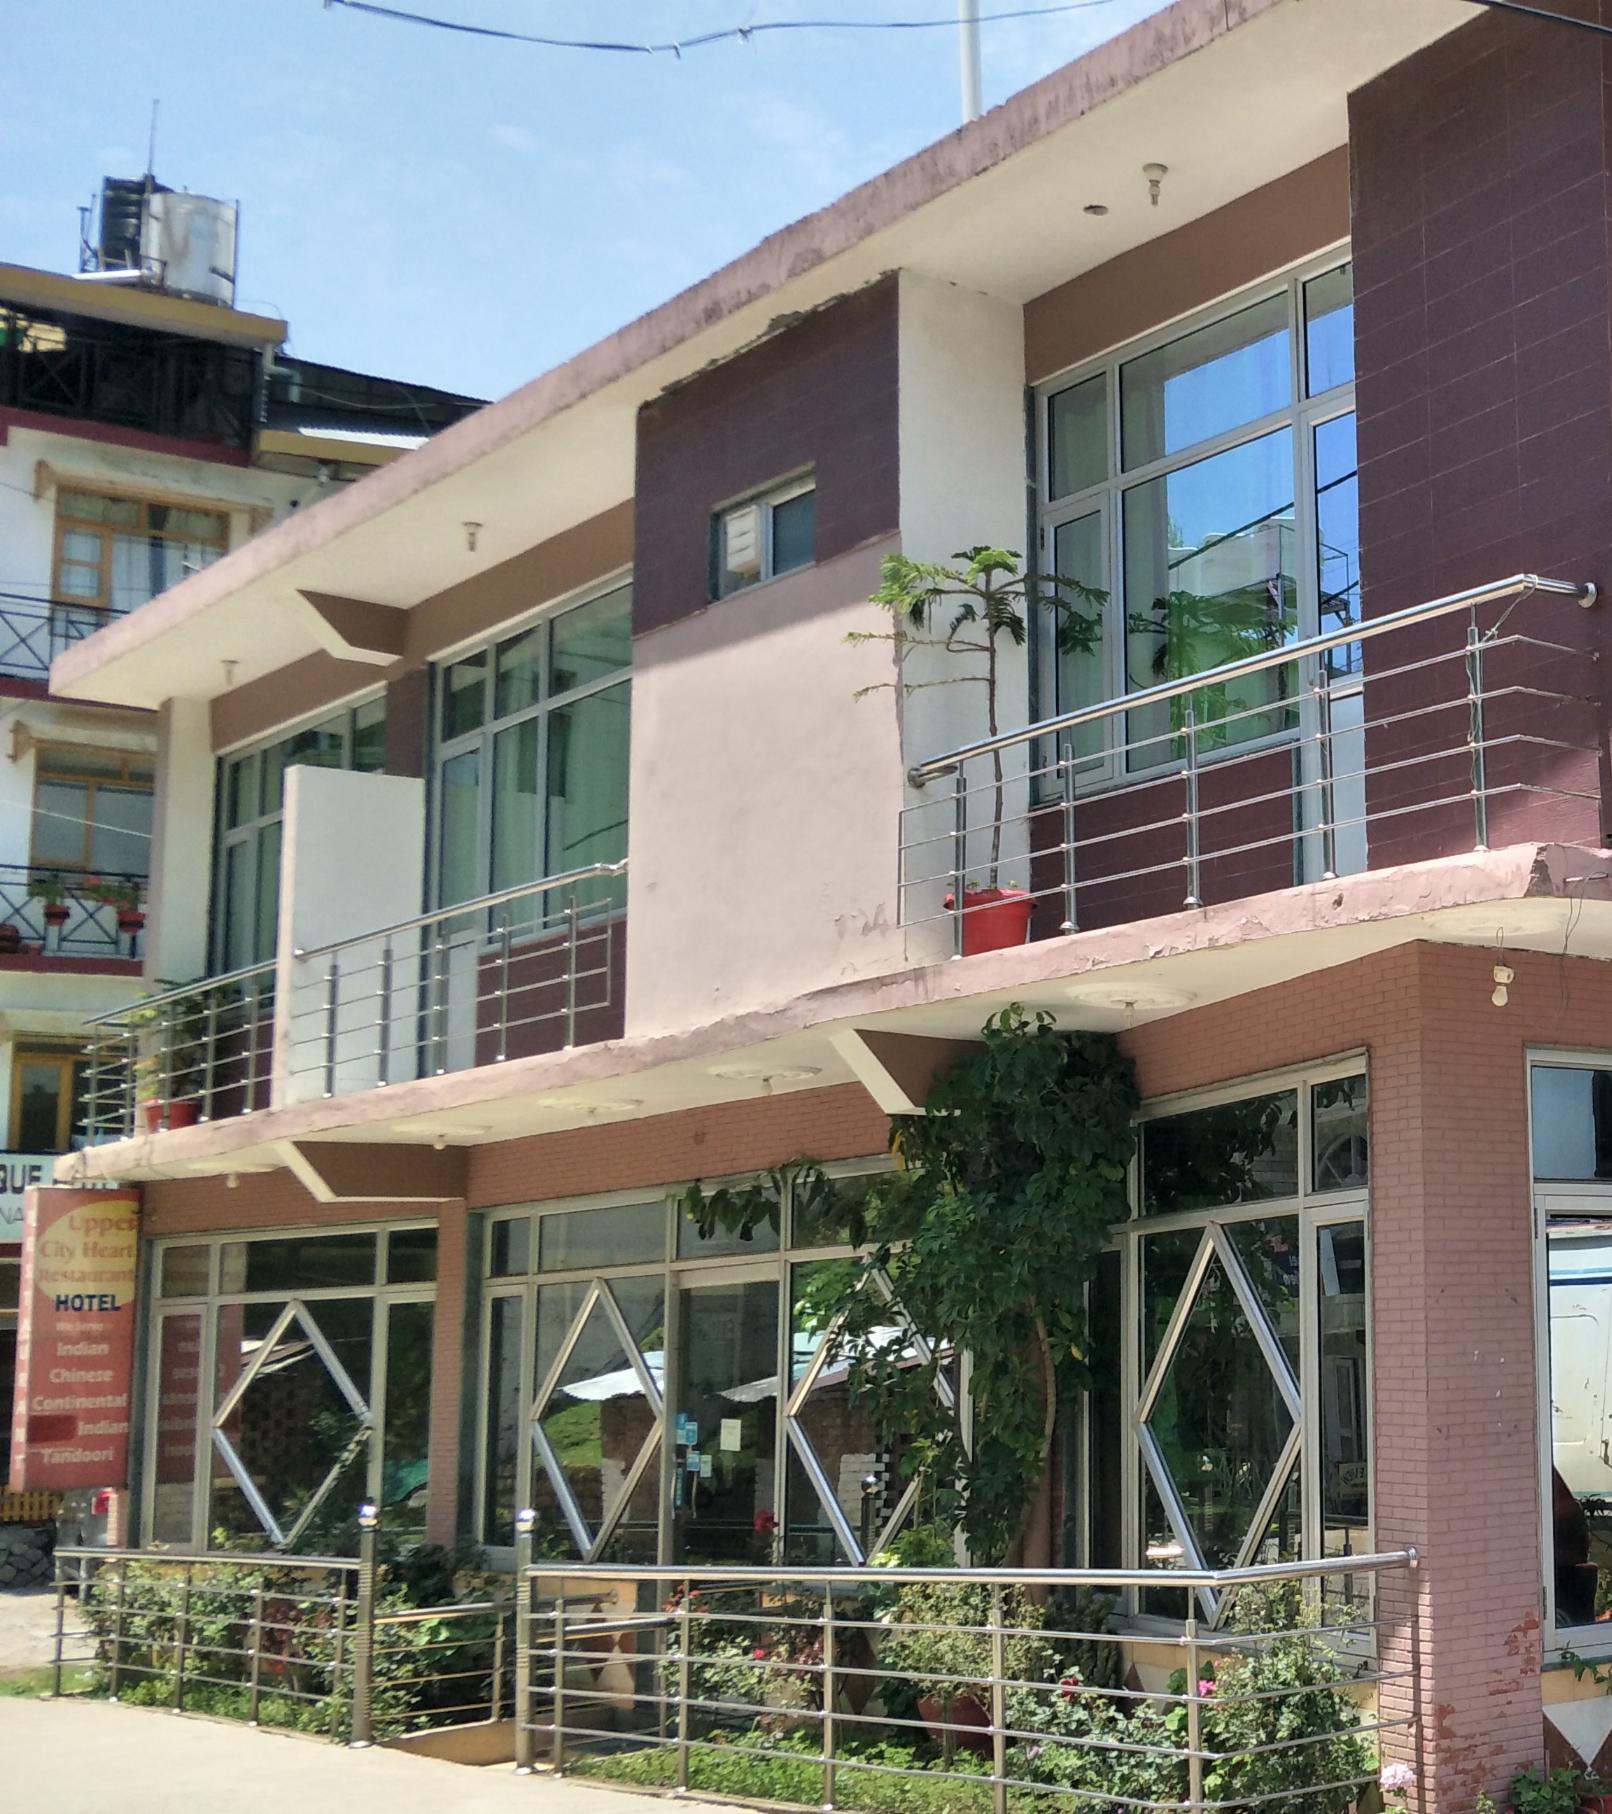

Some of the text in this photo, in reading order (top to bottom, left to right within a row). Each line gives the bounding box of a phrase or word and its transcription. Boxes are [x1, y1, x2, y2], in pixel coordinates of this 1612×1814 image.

[41, 1241, 74, 1264] City
[55, 1293, 121, 1312] HOTEL
[57, 1342, 109, 1356] Indian
[49, 1367, 113, 1384] Chinese
[31, 1393, 128, 1411] Continental
[78, 1420, 128, 1436] Indian
[42, 1446, 114, 1464] Tandoori
